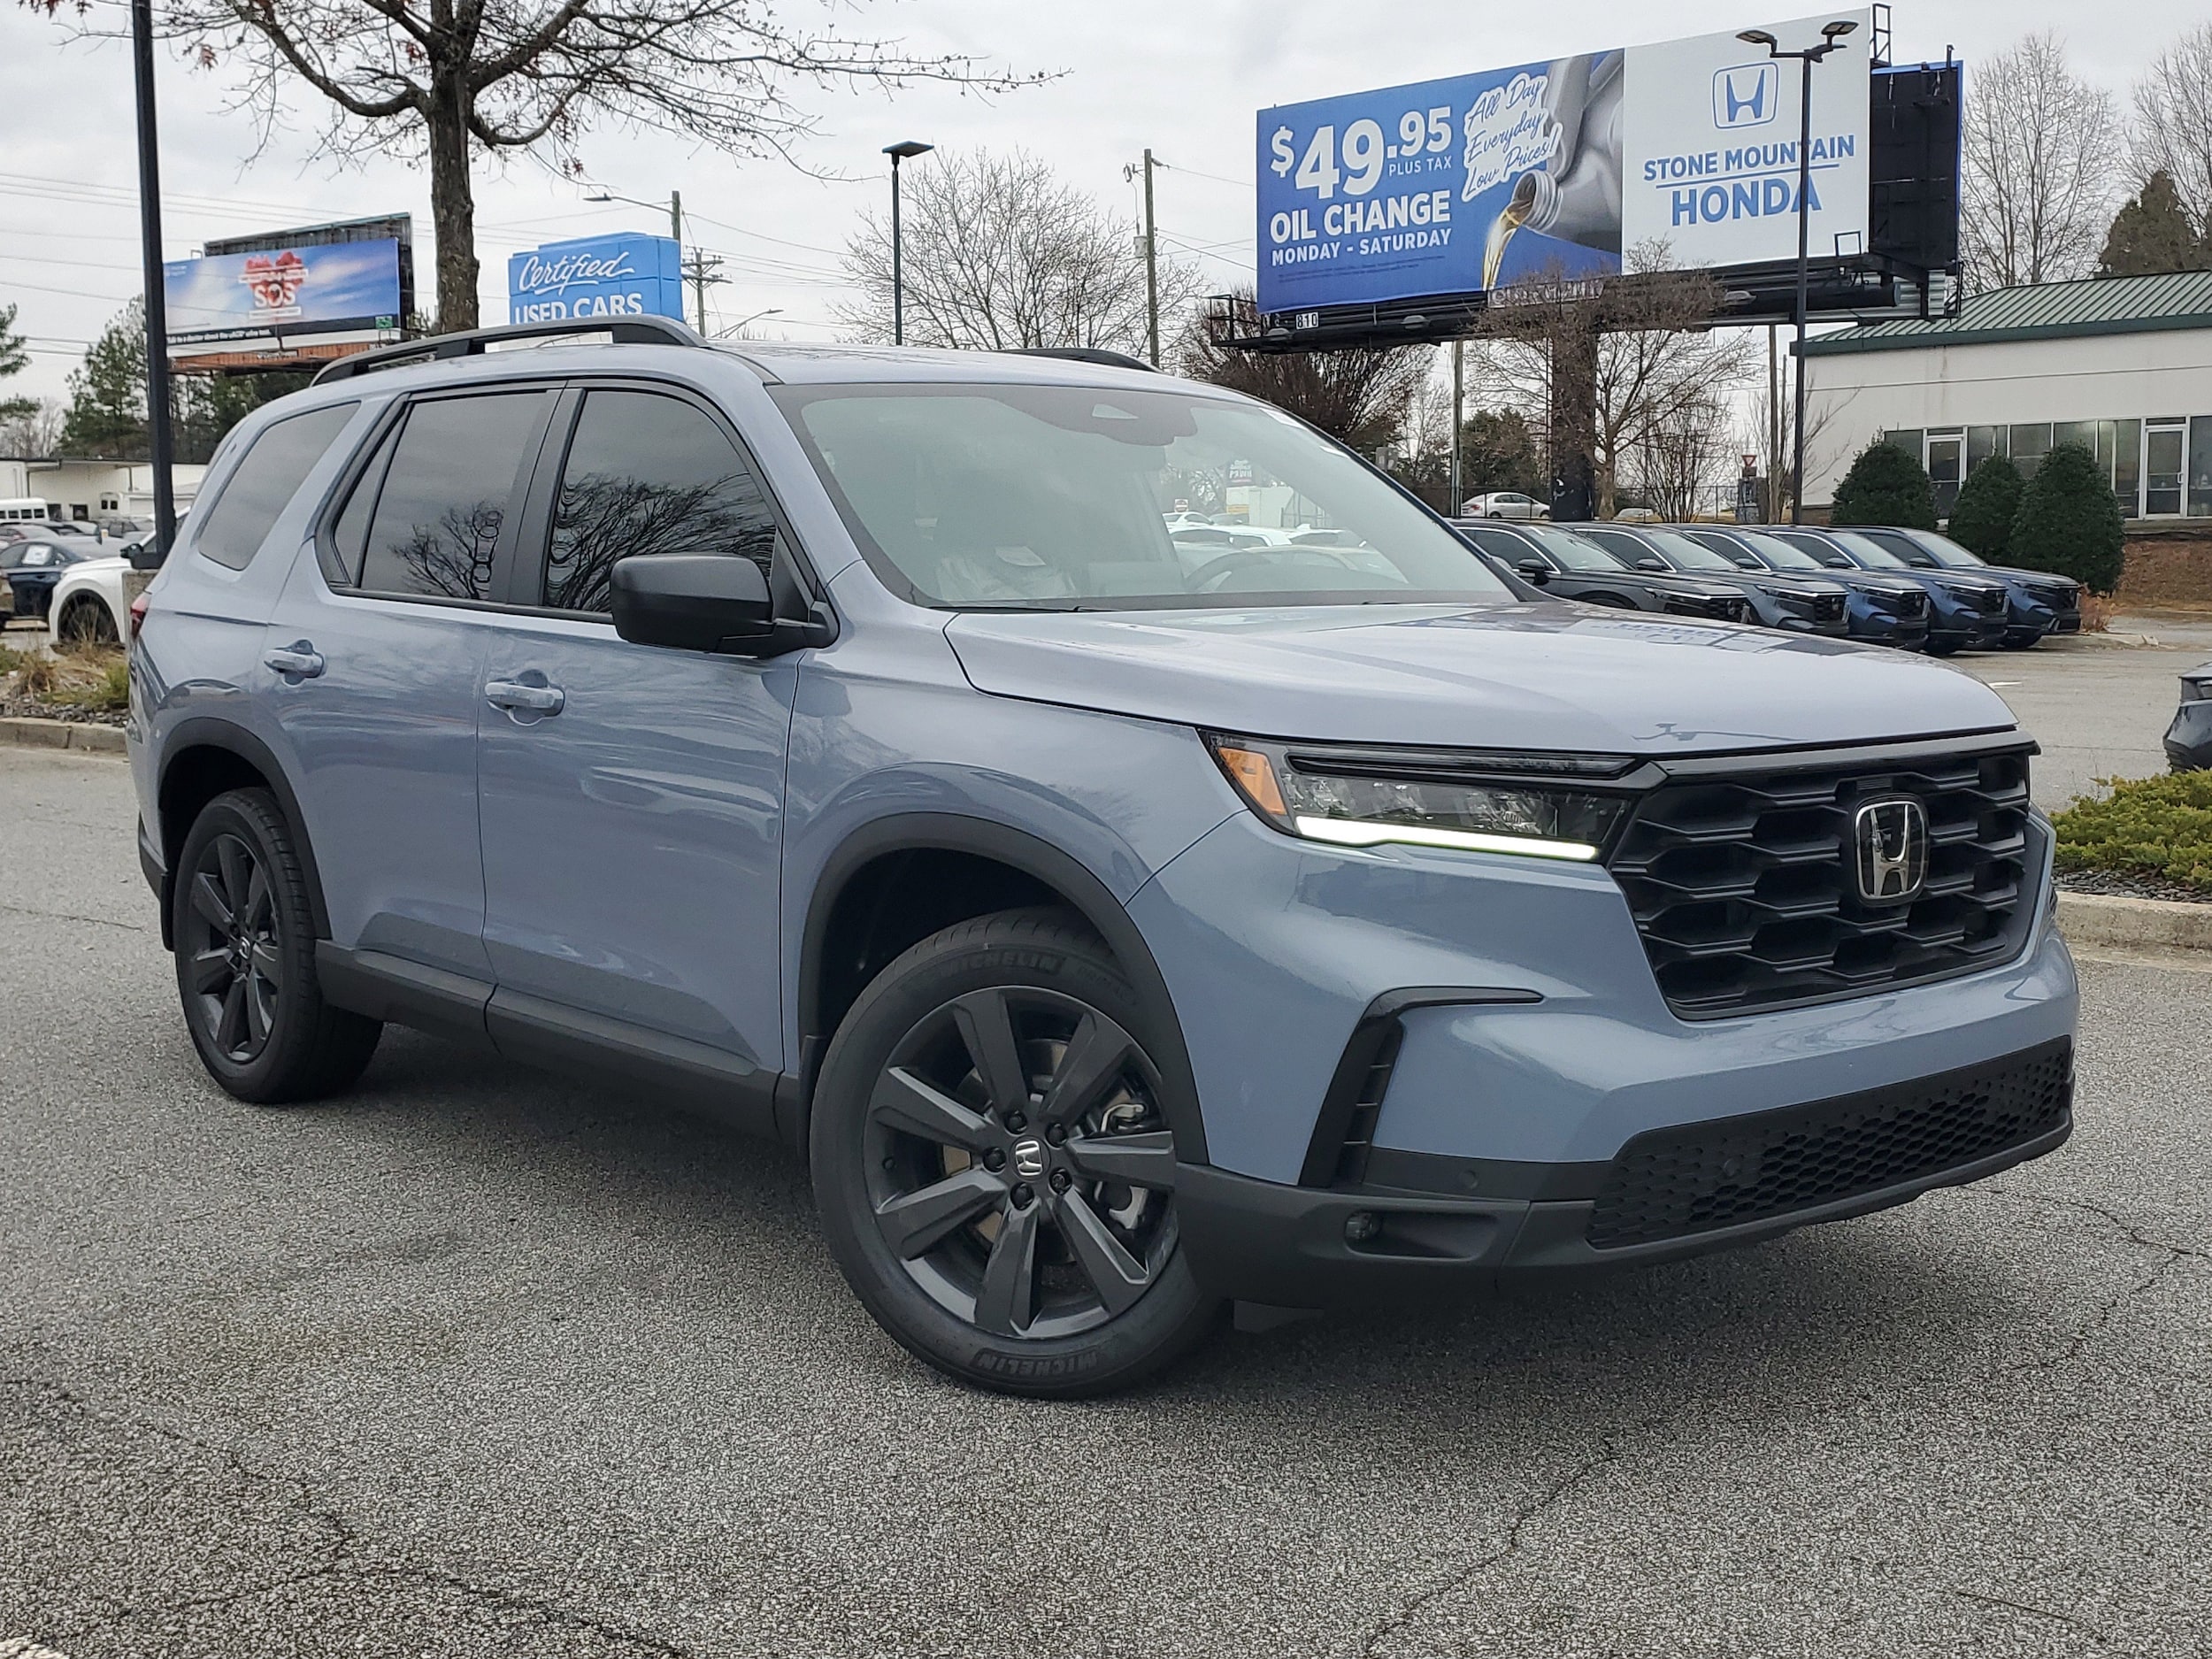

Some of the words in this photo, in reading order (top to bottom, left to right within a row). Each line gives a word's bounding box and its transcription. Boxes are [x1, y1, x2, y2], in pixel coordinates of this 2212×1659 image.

[1468, 92, 1501, 131] All
[1506, 78, 1544, 108] Day
[1468, 110, 1545, 164] Everyday
[1643, 152, 1717, 180] STONE
[1724, 134, 1855, 172] MOUNAIN
[1388, 160, 1421, 176] PLUS
[1427, 156, 1451, 171] TAX
[1465, 166, 1500, 196] Low
[1503, 127, 1559, 177] Prices!
[1271, 210, 1317, 243] OIL
[1324, 190, 1451, 236] CHANGE
[1671, 174, 1823, 227] HONDA
[1271, 242, 1340, 266] MONDAY
[1359, 228, 1452, 255] SATURDAY
[254, 283, 296, 308] SOS
[518, 251, 635, 296] Certified
[515, 301, 567, 325] USED
[572, 293, 642, 318] CARS
[1297, 313, 1317, 328] 810
